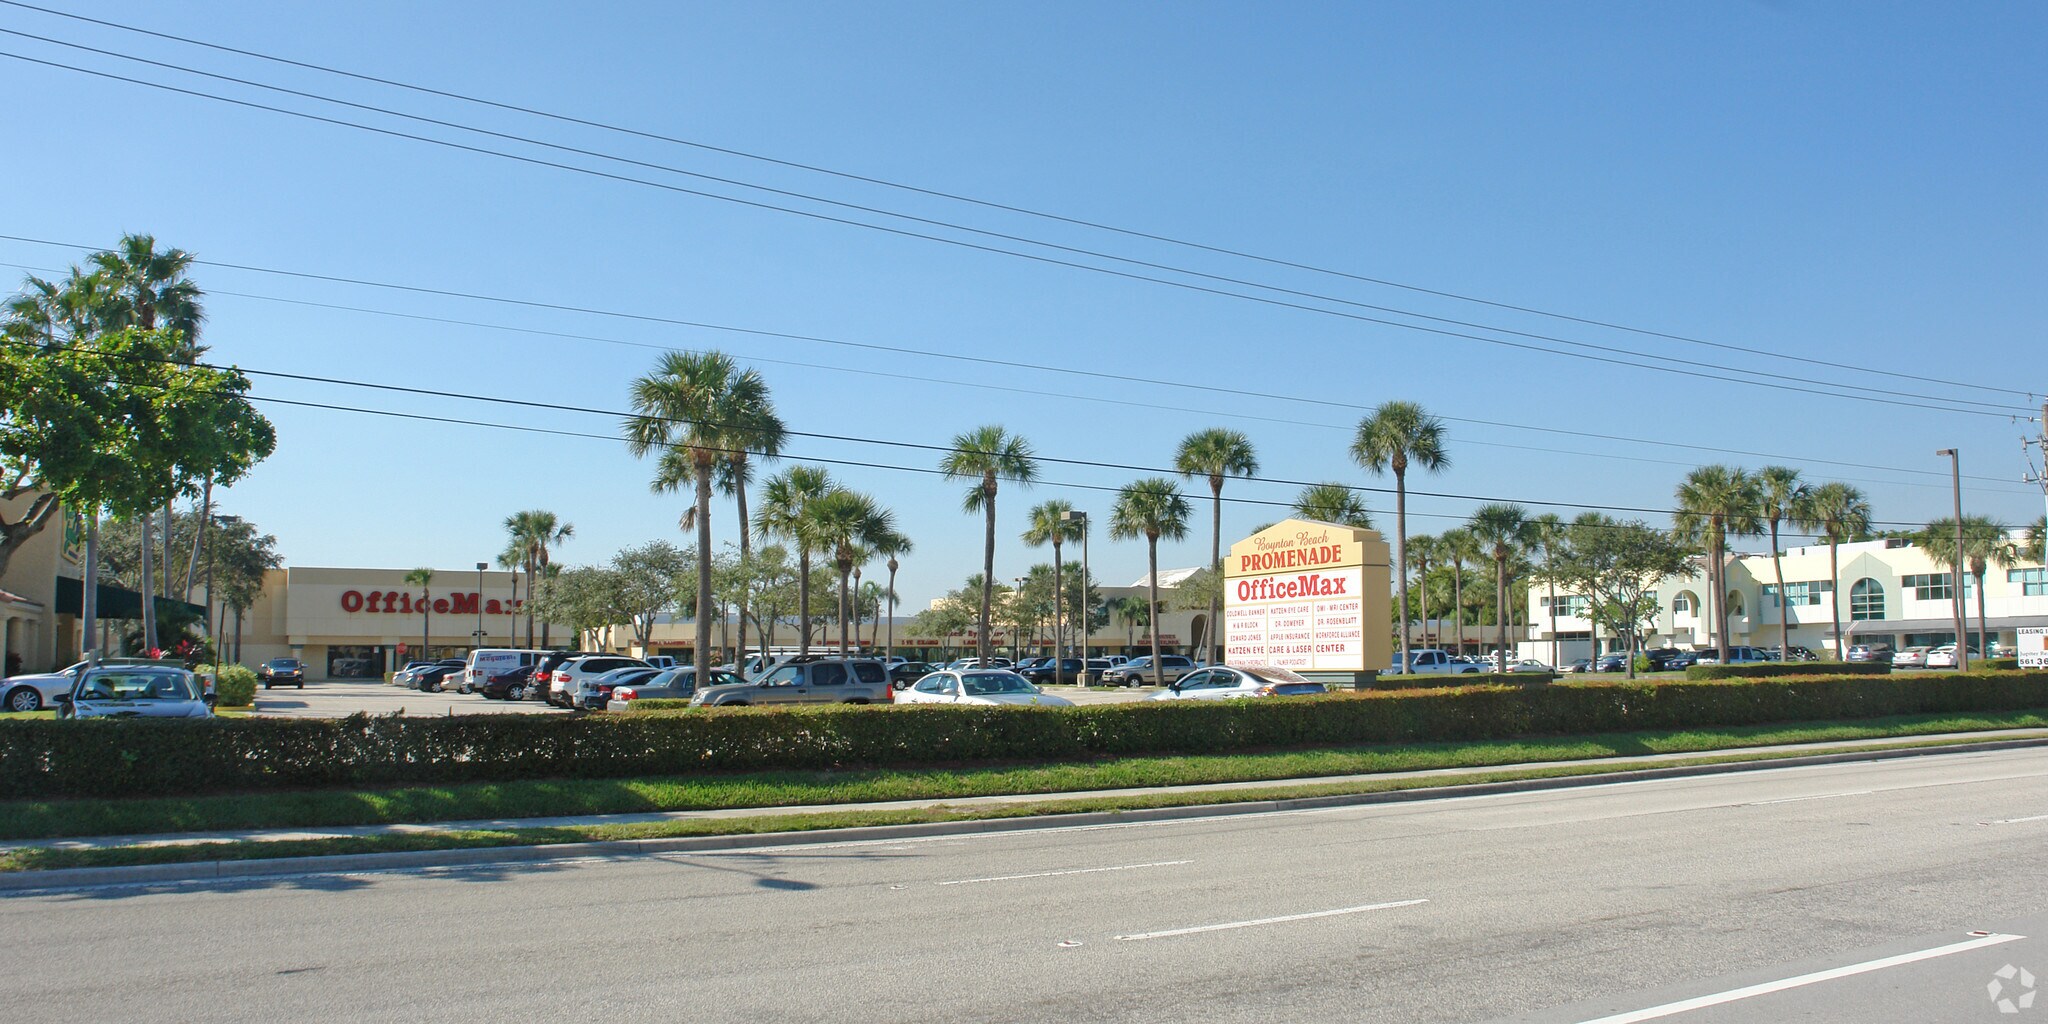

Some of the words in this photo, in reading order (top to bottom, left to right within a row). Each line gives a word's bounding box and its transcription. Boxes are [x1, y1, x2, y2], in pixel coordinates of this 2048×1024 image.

[1254, 537, 1294, 553] Boynton
[1296, 530, 1329, 546] Beach
[1241, 545, 1341, 572] PROMENADE
[1238, 574, 1346, 601] OfficeMax
[1339, 603, 1358, 611] CENTER
[1248, 633, 1261, 641] JONES
[1228, 646, 1251, 655] KATZEN
[1252, 646, 1265, 654] EYE
[1269, 645, 1285, 654] CARE
[1286, 645, 1290, 654] &
[1292, 644, 1312, 653] LASER
[1315, 643, 1345, 653] CENTER
